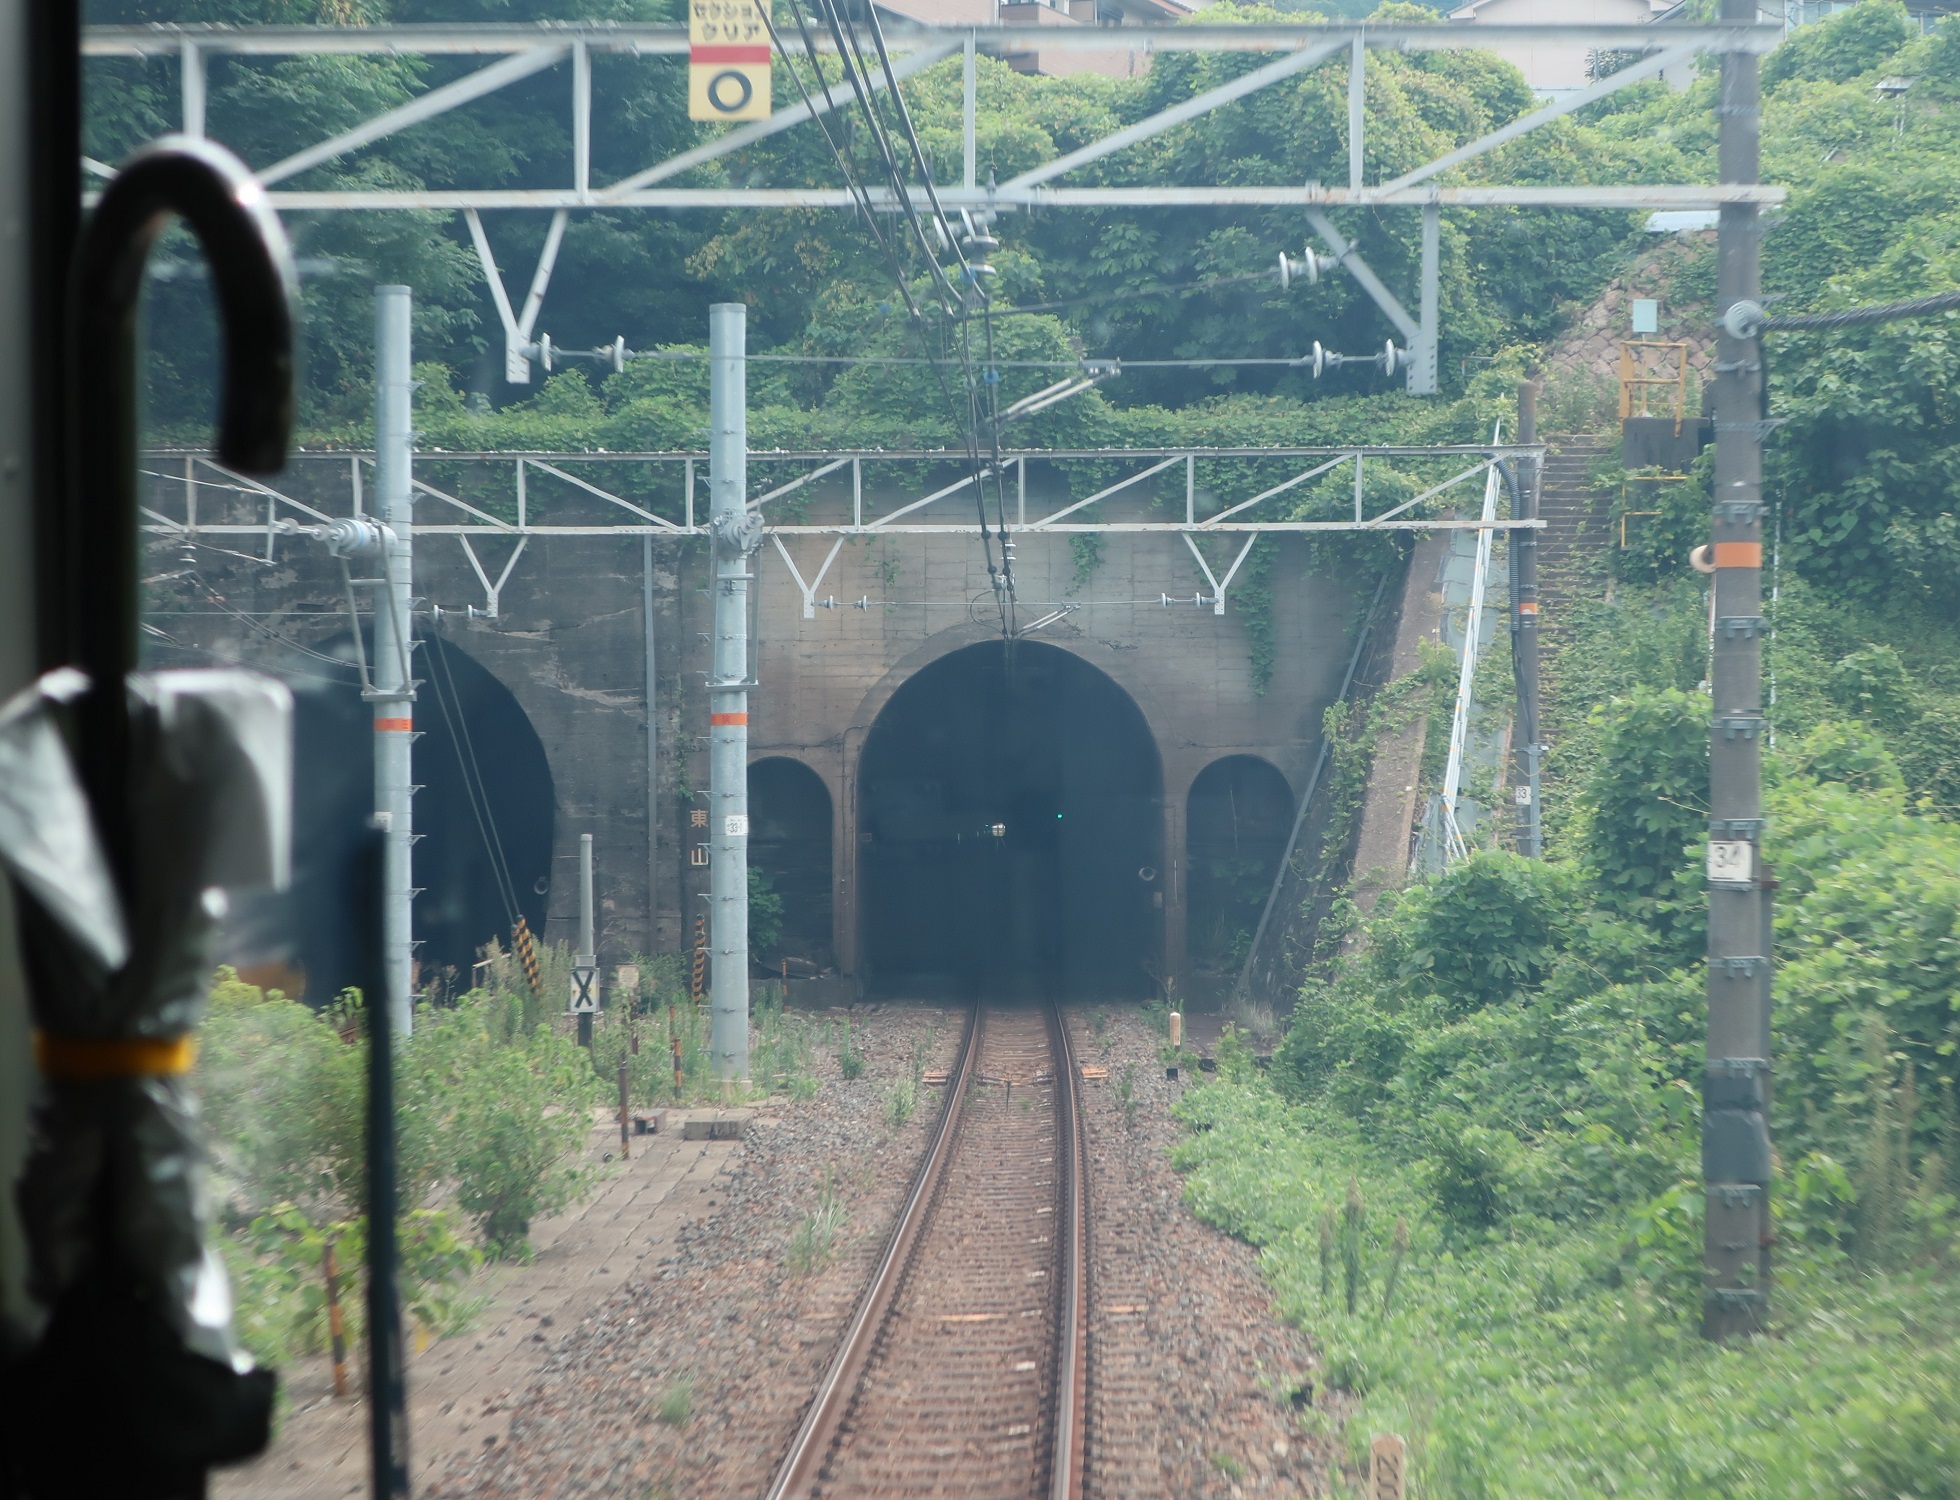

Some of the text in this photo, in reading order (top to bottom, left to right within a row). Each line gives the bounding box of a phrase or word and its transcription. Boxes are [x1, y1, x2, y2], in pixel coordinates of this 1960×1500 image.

[701, 22, 760, 41] クリア
[689, 808, 709, 866] 東山
[1713, 845, 1741, 869] 34
